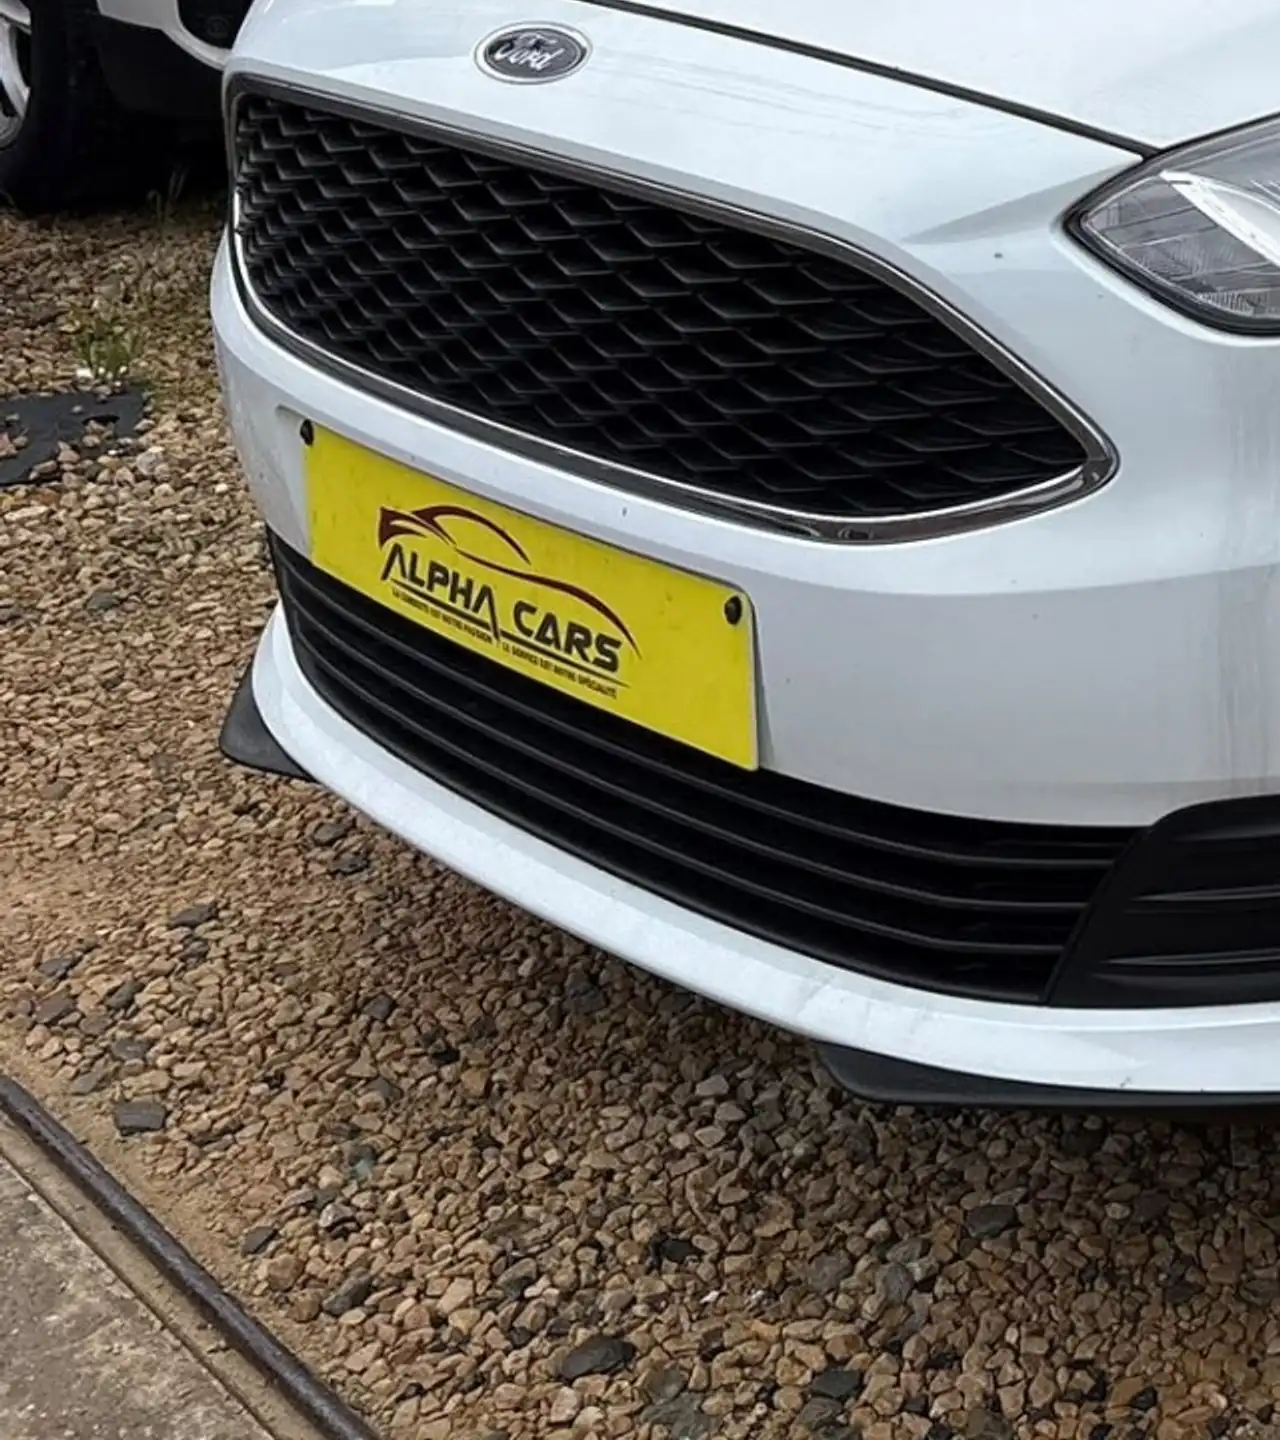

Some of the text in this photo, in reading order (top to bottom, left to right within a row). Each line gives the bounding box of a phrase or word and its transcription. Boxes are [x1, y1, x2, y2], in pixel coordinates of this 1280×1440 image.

[493, 32, 566, 72] Ford
[381, 543, 622, 674] ALPHA CARS
